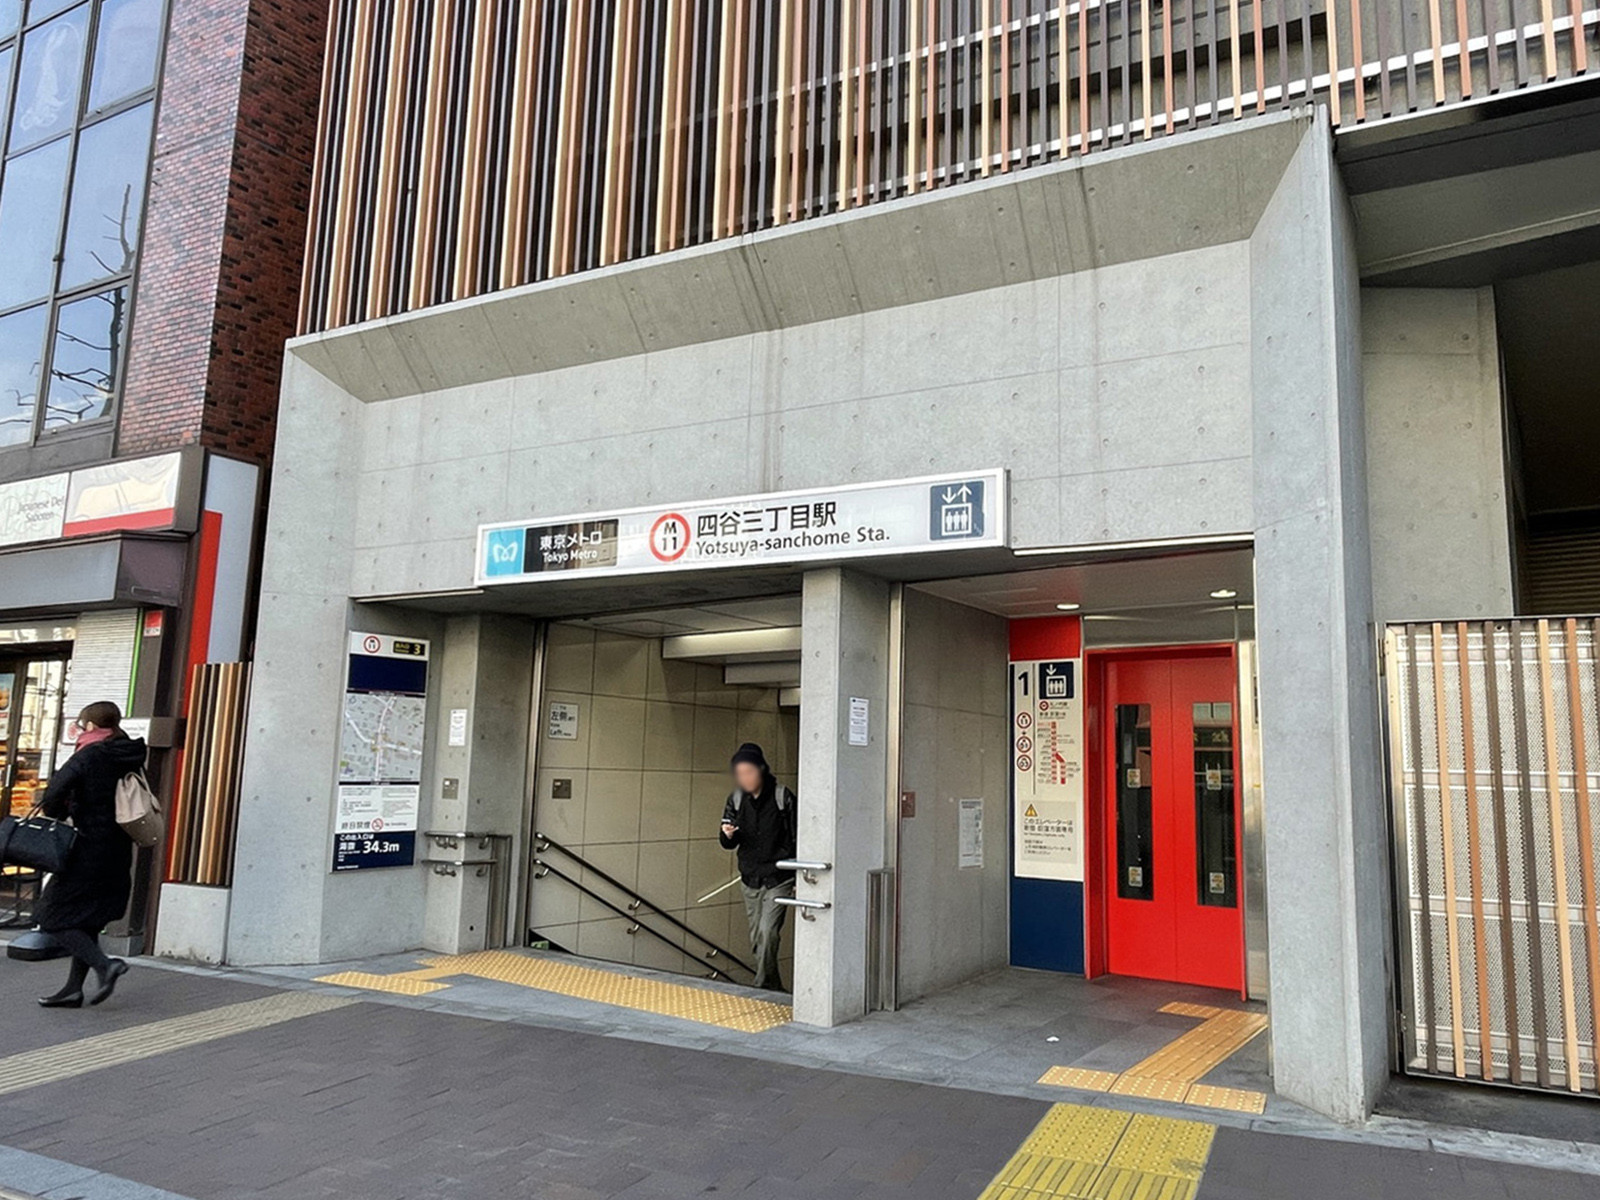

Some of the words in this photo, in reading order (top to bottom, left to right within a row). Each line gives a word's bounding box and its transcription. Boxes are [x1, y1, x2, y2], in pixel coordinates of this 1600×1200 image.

[697, 501, 837, 538] 四谷三丁目駅
[663, 522, 677, 534] M
[540, 531, 602, 550] 東京メトロ
[662, 537, 678, 551] 11
[696, 530, 851, 557] Yotsuya-sanchome
[857, 526, 890, 543] Sta.
[543, 551, 569, 563] Tokyo
[570, 549, 598, 560] Metro
[413, 643, 421, 655] 3
[1018, 671, 1028, 696] 1
[363, 840, 400, 854] 34.3m
